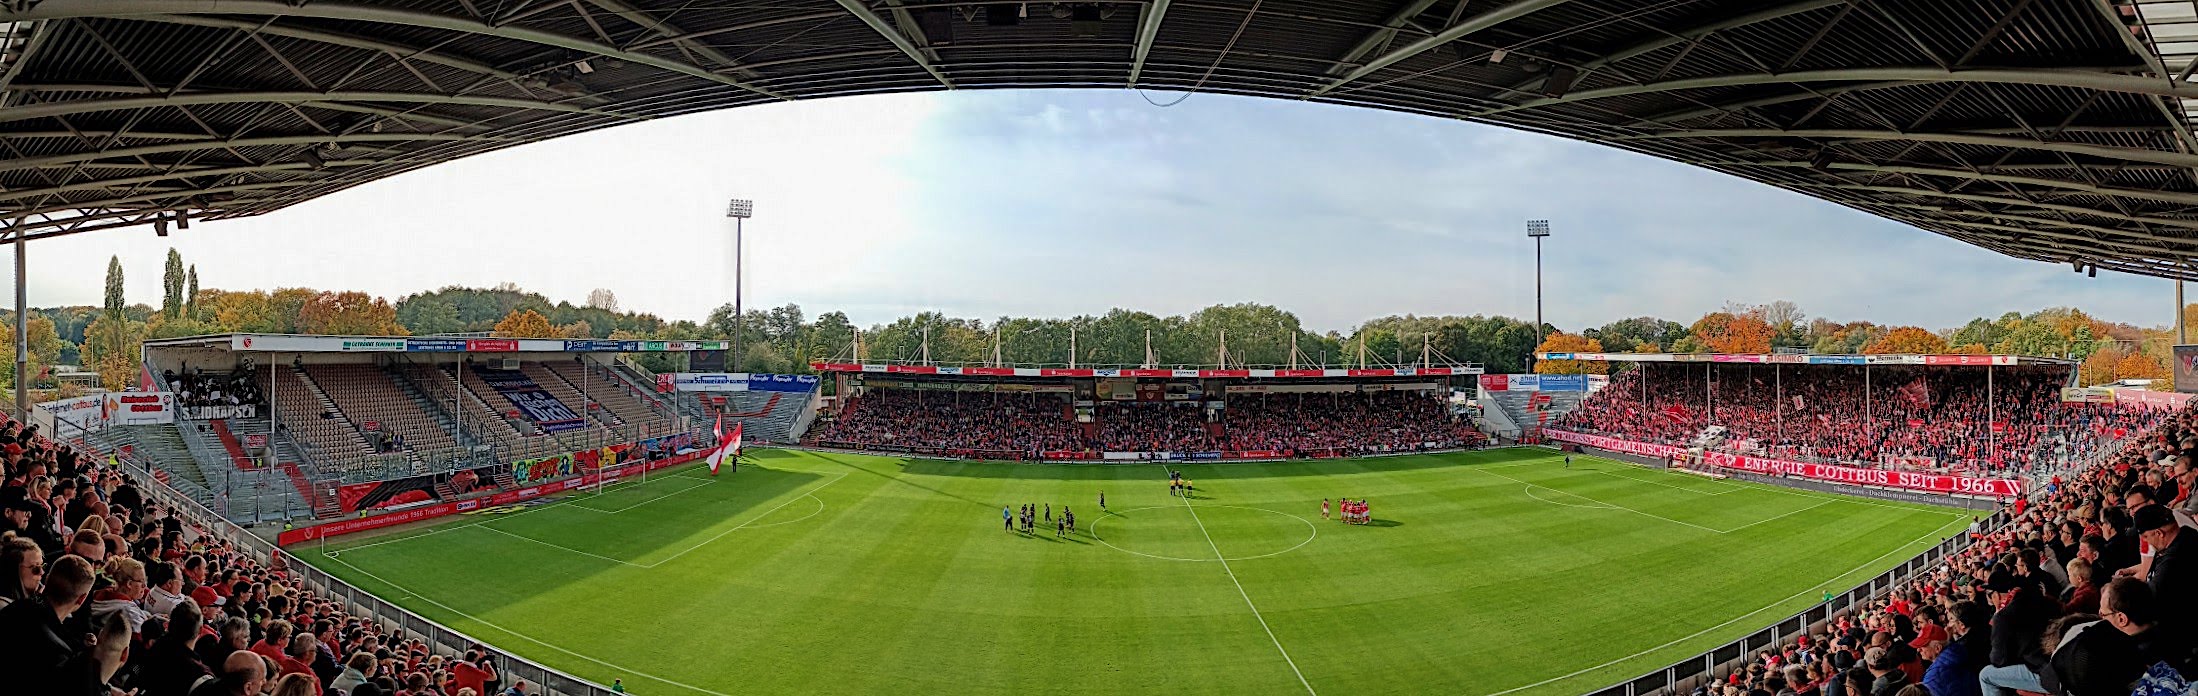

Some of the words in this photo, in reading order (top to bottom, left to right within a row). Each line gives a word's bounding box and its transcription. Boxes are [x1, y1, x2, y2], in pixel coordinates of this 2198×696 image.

[182, 404, 256, 420] SDHAUSEN
[1744, 457, 1806, 475] ENERGIE
[1815, 465, 1888, 483] COTTBUS
[1899, 474, 1938, 489] SEIT
[1951, 477, 1995, 493] 1966
[320, 525, 346, 535] Unsere
[345, 513, 409, 530] Unternehmerfreunde
[425, 506, 449, 517] Tradition
